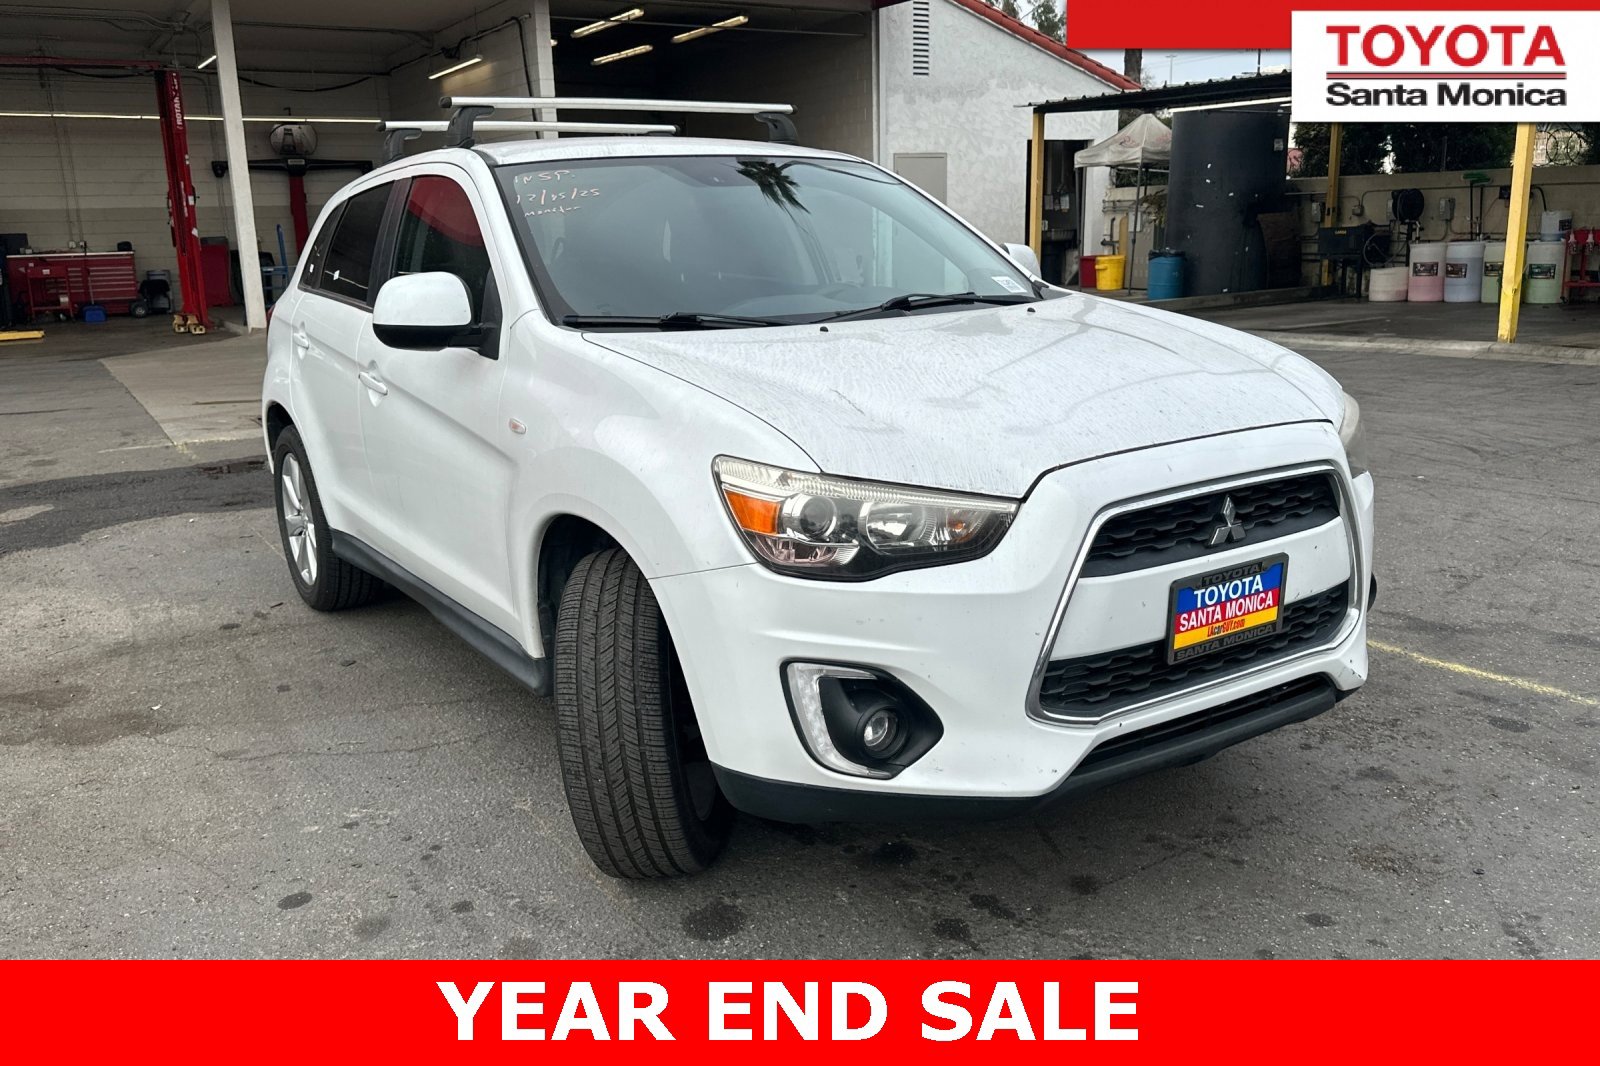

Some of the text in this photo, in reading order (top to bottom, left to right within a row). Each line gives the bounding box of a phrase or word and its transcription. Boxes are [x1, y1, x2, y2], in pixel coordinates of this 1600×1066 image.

[1194, 574, 1264, 608] TOYOTA
[1203, 563, 1260, 585] TOYOTA
[1180, 590, 1273, 632] SANTA MONICA
[1177, 624, 1274, 660] SANTA MONICA
